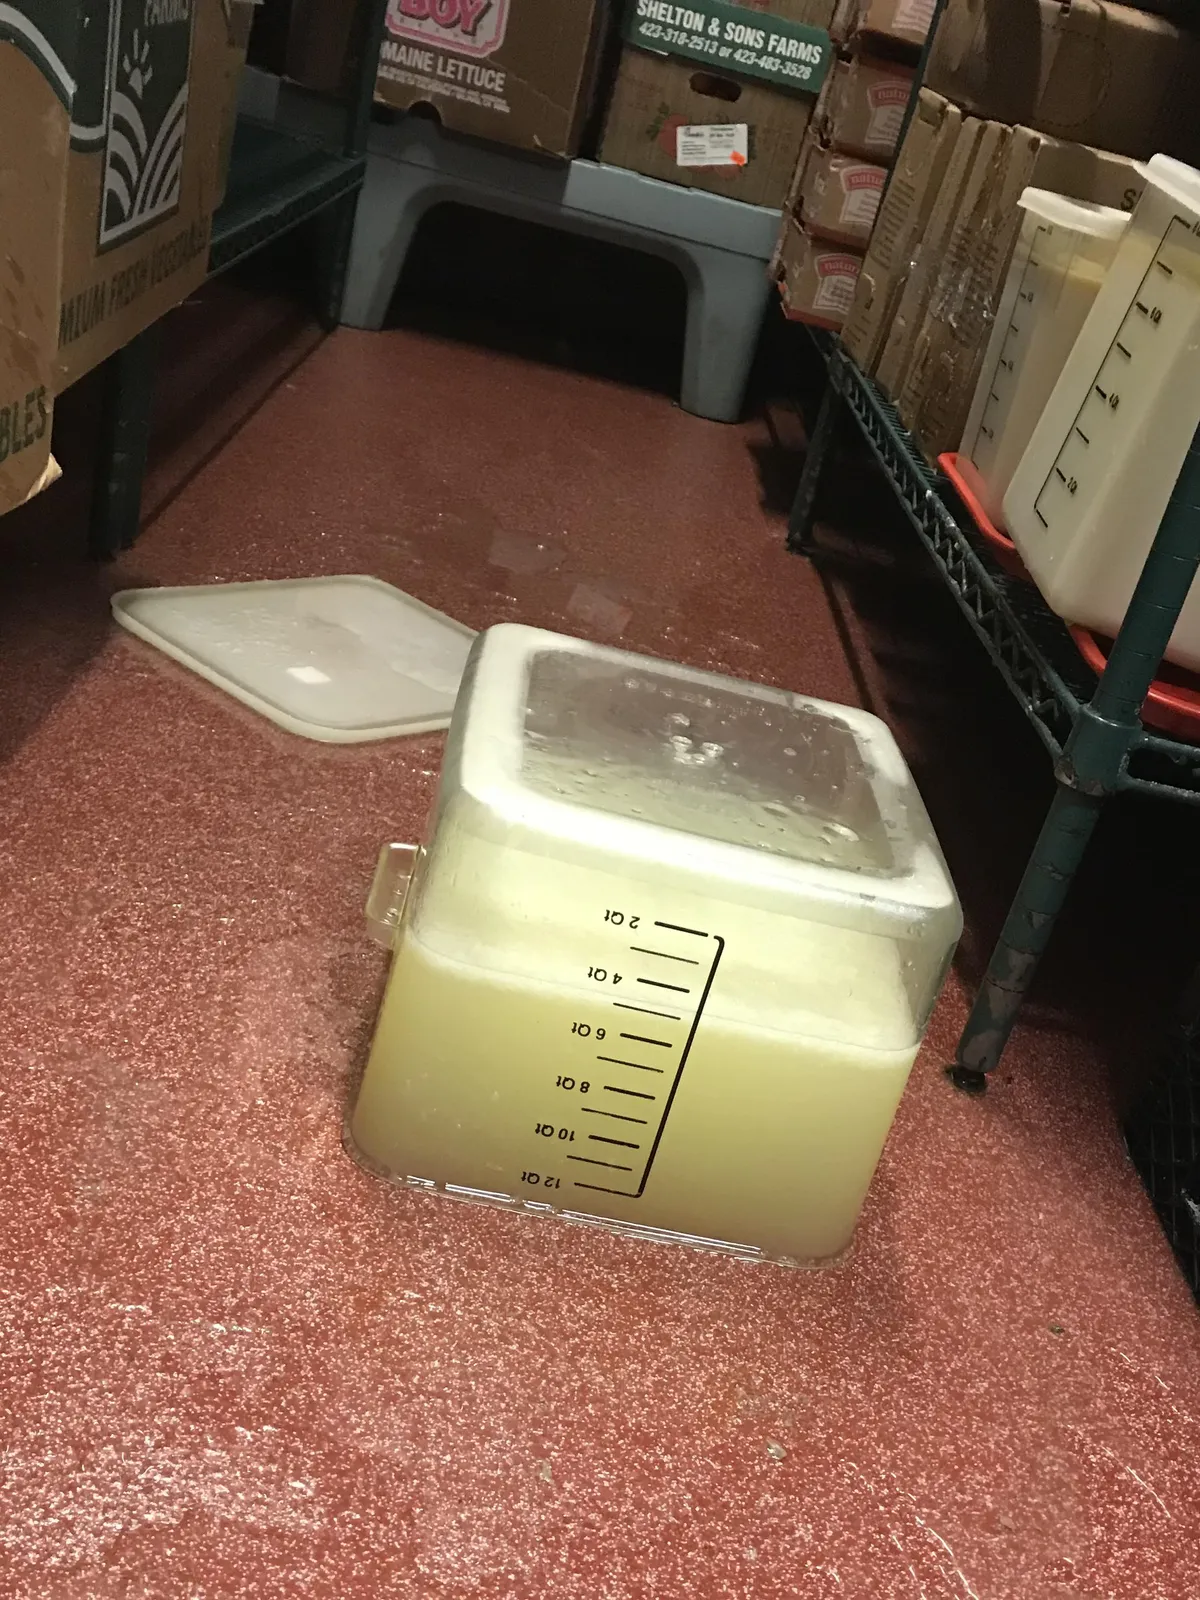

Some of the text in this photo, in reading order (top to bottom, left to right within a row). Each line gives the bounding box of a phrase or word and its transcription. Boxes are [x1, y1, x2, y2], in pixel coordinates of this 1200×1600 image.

[399, 0, 492, 35] BOY
[637, 0, 823, 64] SHELTON & SONS FARMS
[638, 21, 719, 54] 423-318-2513
[718, 45, 733, 58] or
[436, 55, 506, 92] LETTUCE
[603, 908, 641, 930] 2 Qt
[587, 966, 623, 985] 4 Qt
[571, 1021, 607, 1041] 6 Qt
[555, 1075, 591, 1094] 8 Qt
[534, 1122, 575, 1142] 10 Qt
[520, 1170, 561, 1190] 12 Qt
